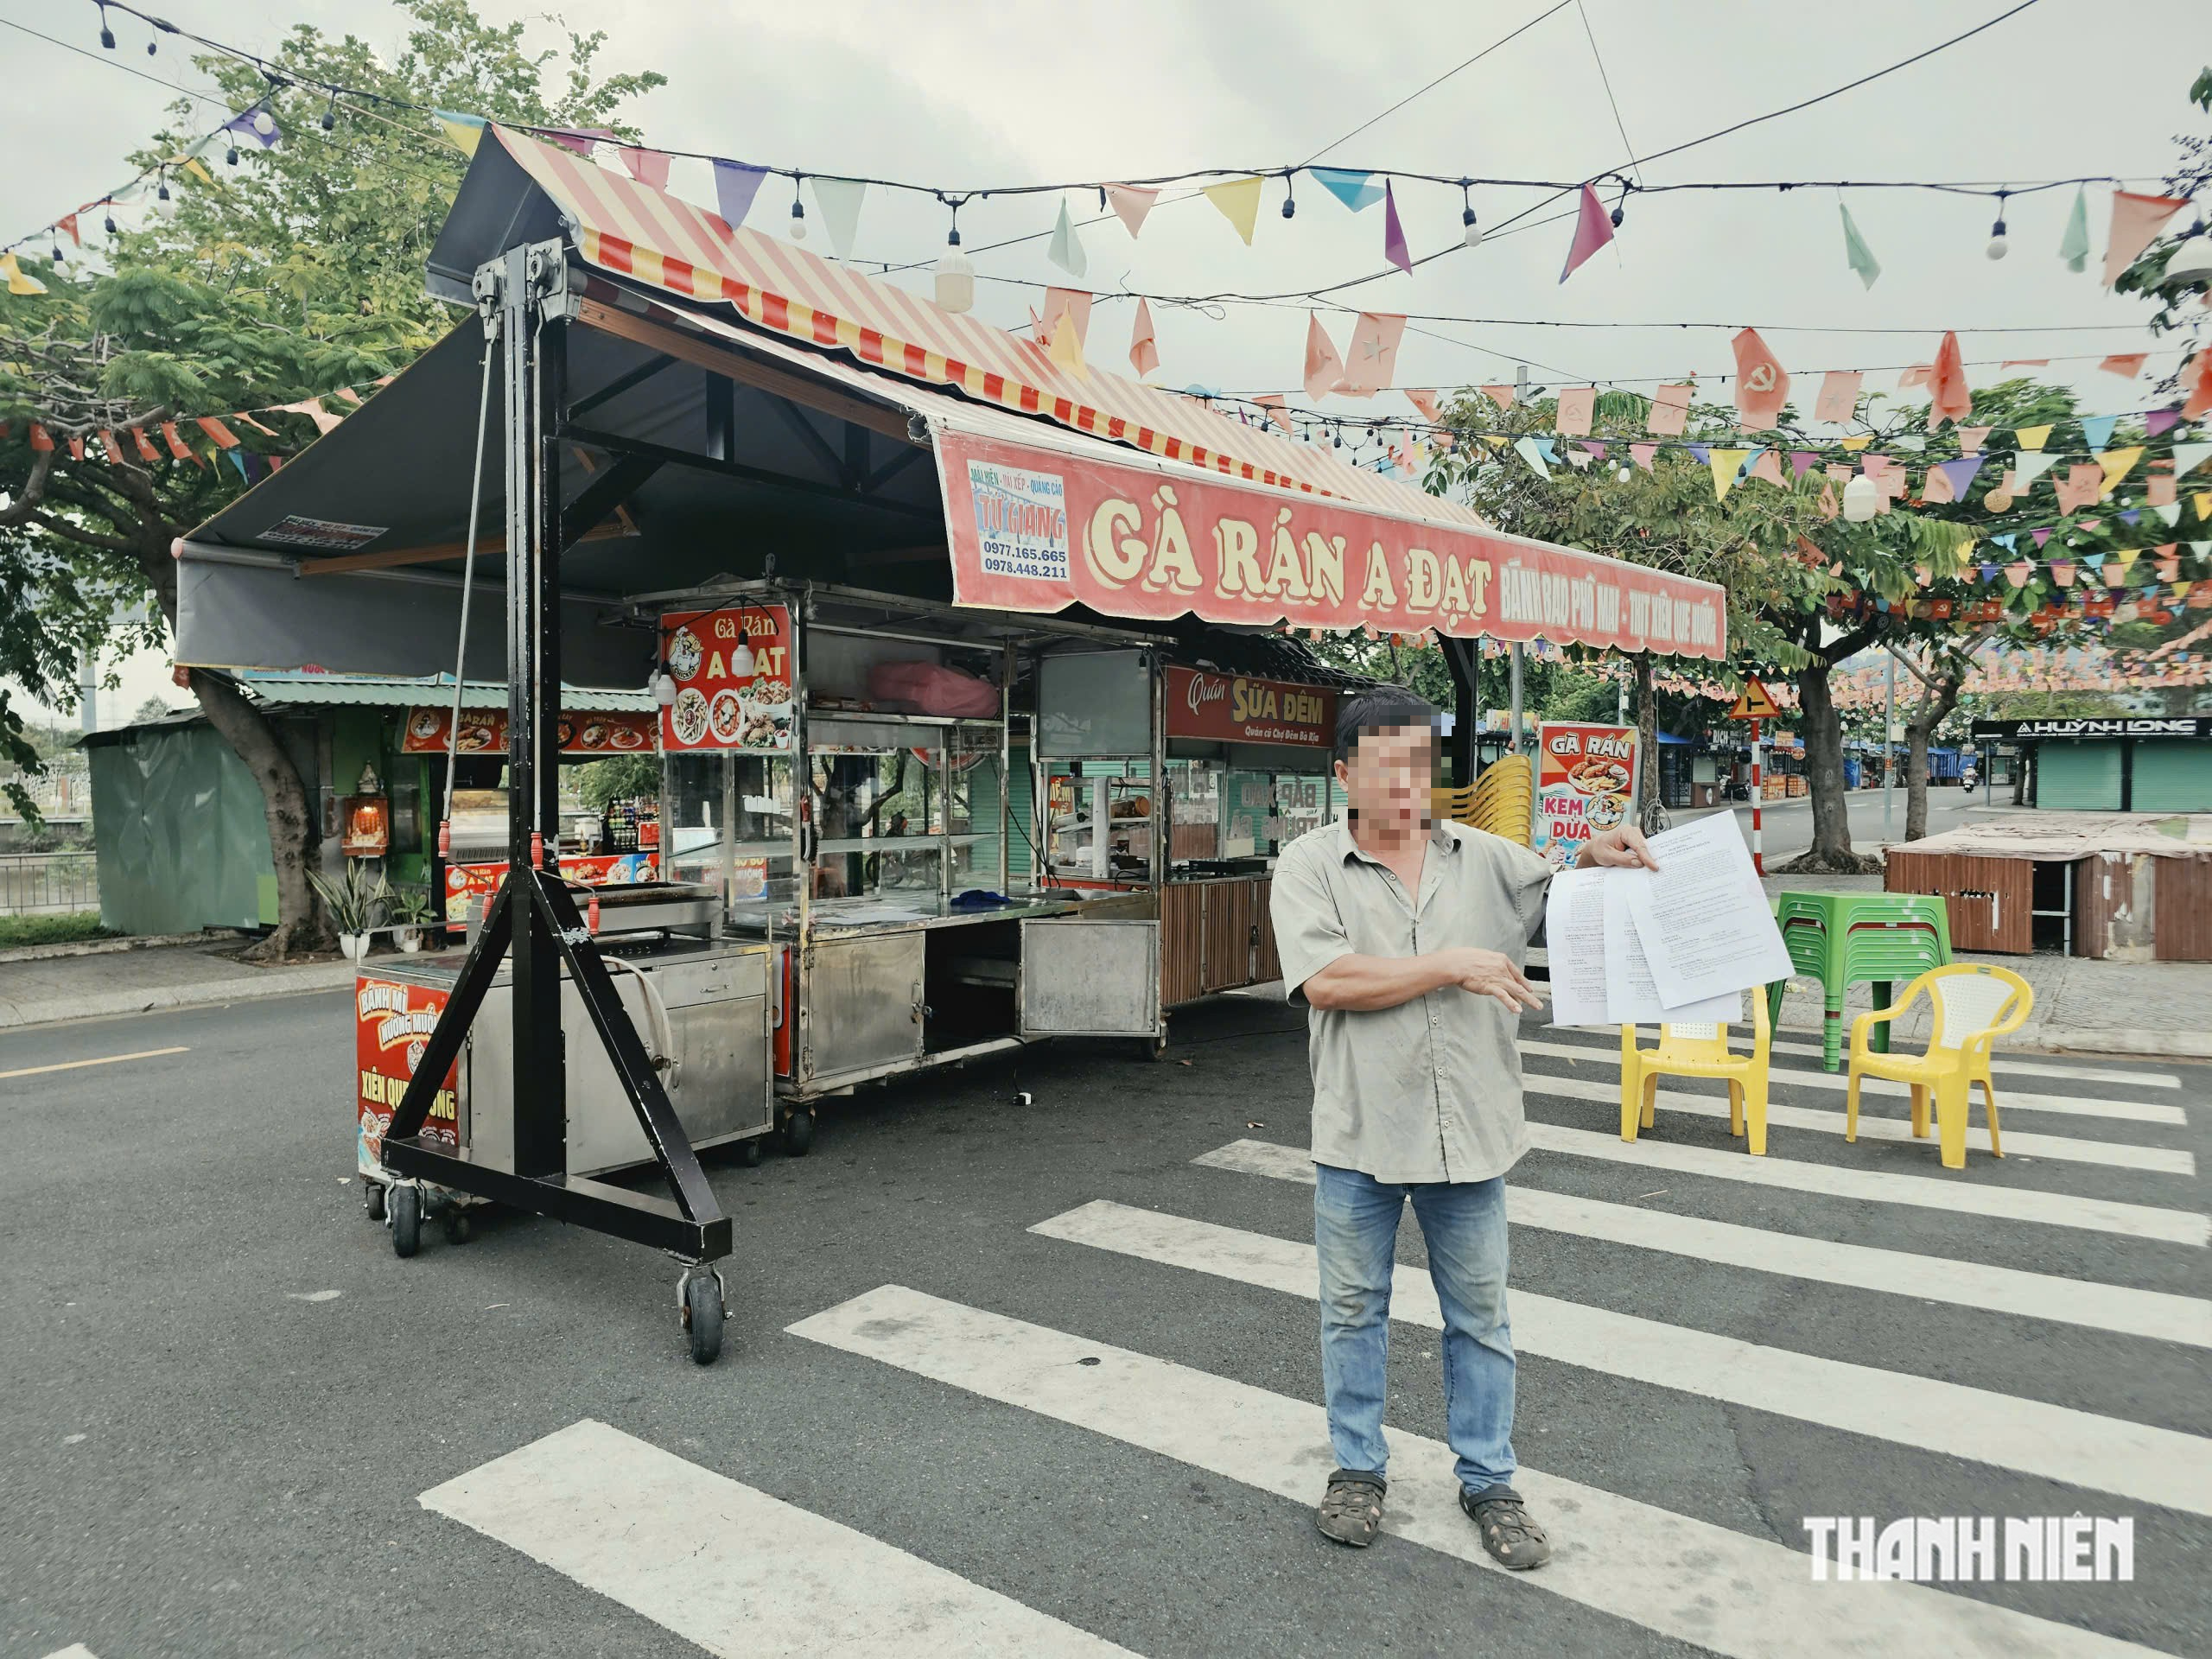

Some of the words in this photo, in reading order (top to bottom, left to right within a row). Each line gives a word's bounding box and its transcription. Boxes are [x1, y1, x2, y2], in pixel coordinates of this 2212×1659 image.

[1007, 501, 1064, 540] GIANG
[983, 541, 1066, 563] 0977.165.665
[1084, 485, 1204, 594] GÀ
[1213, 508, 1346, 607] RÁN
[1358, 541, 1399, 611] A
[1403, 548, 1493, 632] ĐẠT
[985, 558, 1067, 579] 0978.448.211
[715, 618, 735, 639] Gà
[707, 651, 727, 679] A
[1187, 672, 1225, 715] Quán
[1232, 677, 1279, 722] SỮA
[1283, 690, 1323, 724] ĐÊM
[1245, 725, 1263, 737] Quán
[2034, 718, 2123, 733] HUỲNH
[2126, 720, 2196, 732] LONG
[1550, 732, 1580, 754] GÀ
[1586, 734, 1631, 760] RÁN
[1545, 798, 1583, 816] KEM
[1553, 818, 1592, 841] DỪA
[360, 983, 390, 1016] BÁNH
[391, 985, 407, 1015] MÌ
[361, 1065, 386, 1104] XIÊN
